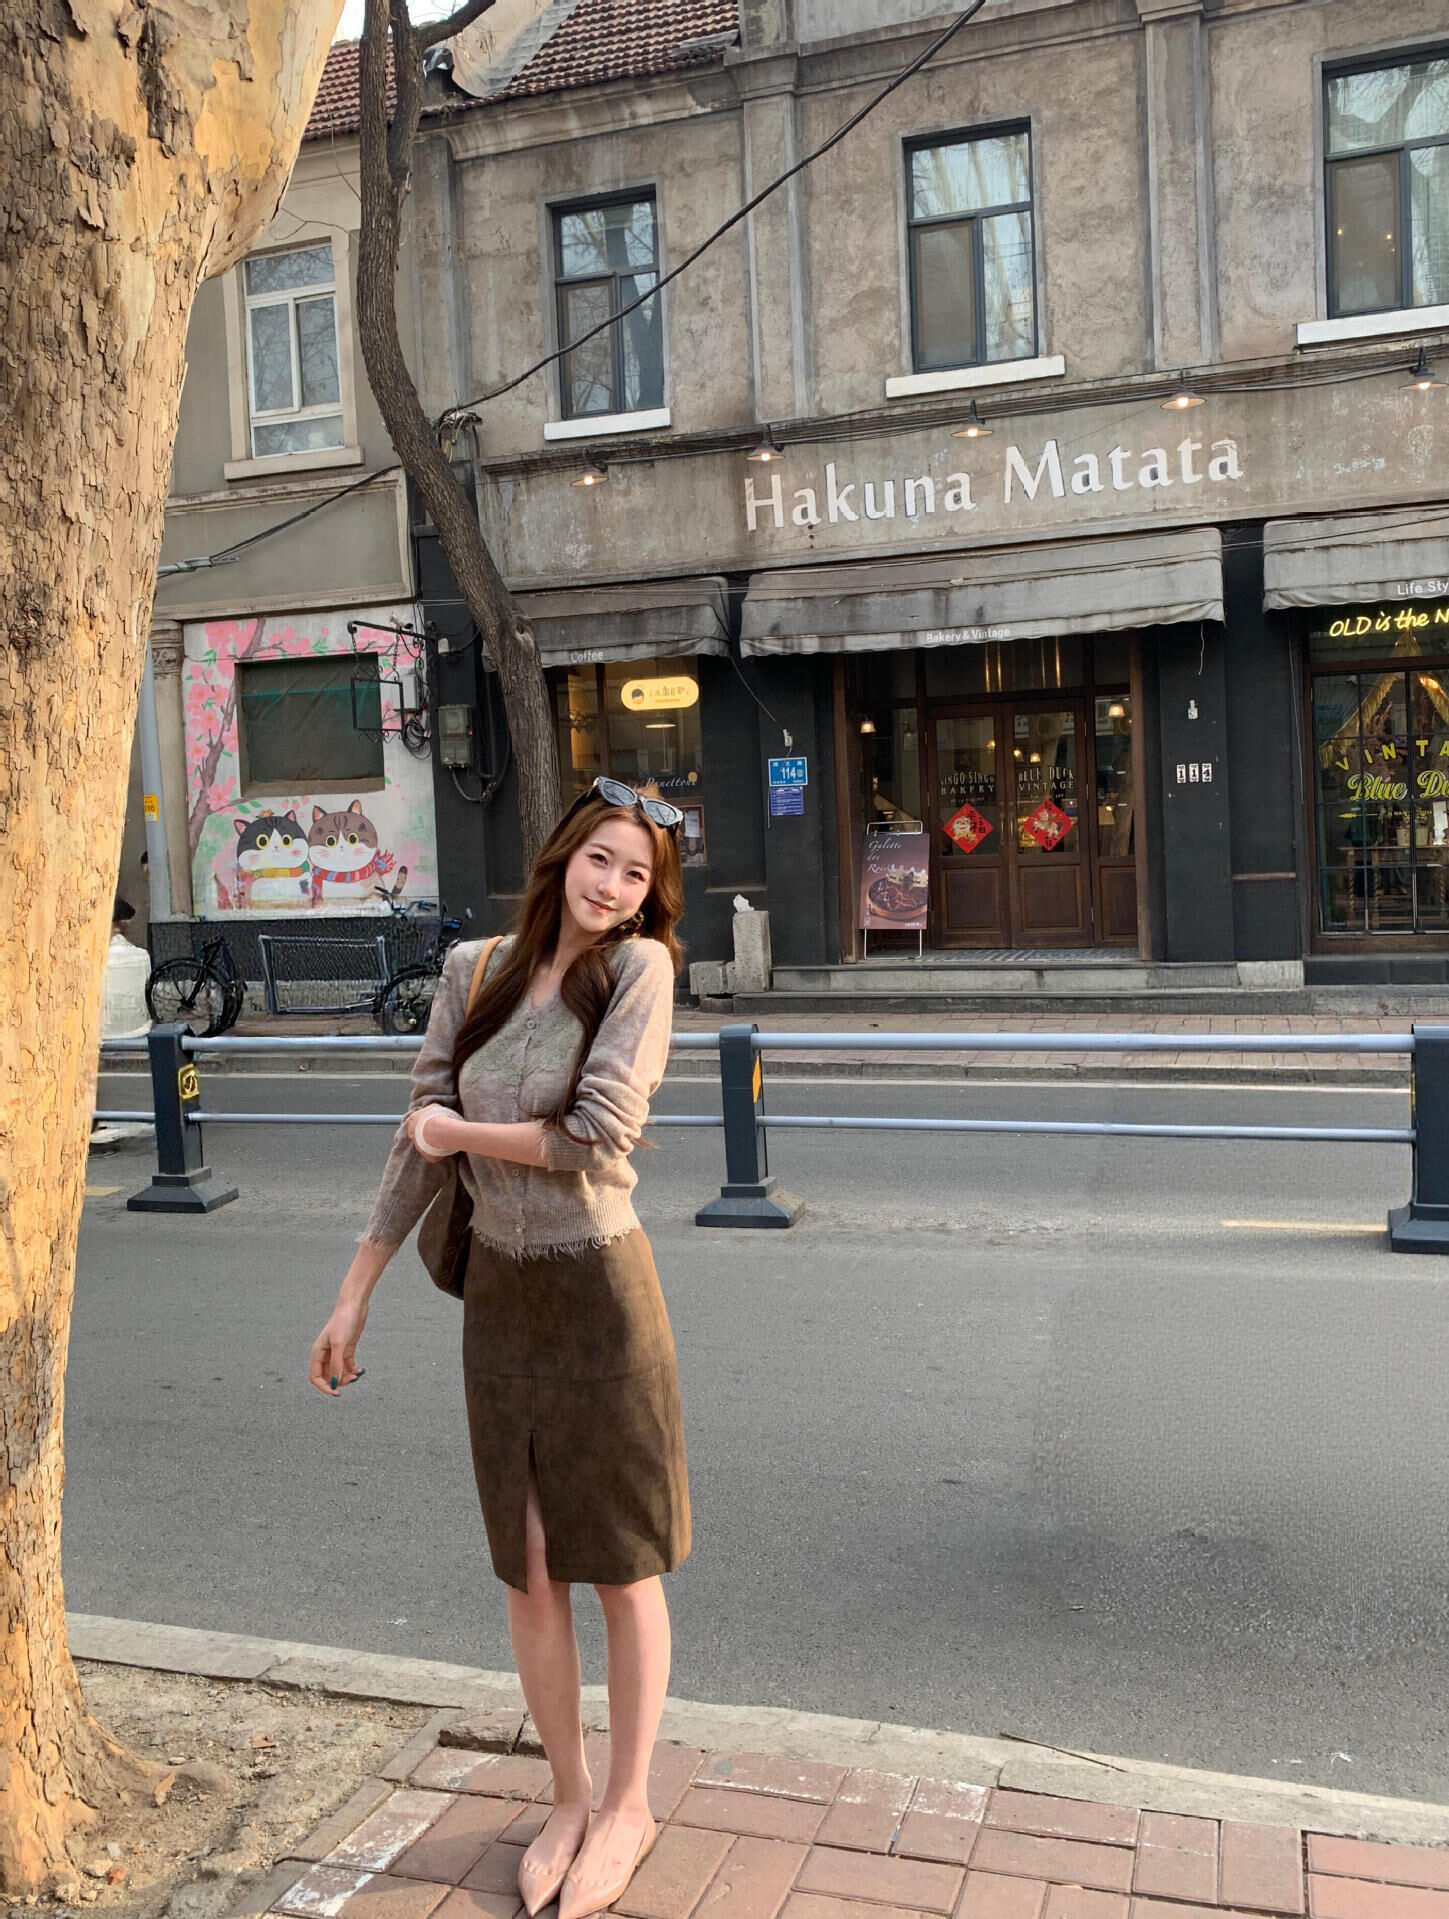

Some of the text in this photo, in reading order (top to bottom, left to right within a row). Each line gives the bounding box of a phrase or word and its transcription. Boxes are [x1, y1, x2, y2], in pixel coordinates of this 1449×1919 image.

[744, 437, 1245, 532] Hakuna Matata
[1397, 582, 1423, 595] Life
[1329, 616, 1371, 637] OLD
[1375, 610, 1391, 631] is
[1394, 608, 1429, 629] the
[926, 628, 1010, 643] Bakery & Vintage
[571, 650, 604, 663] Coffee
[781, 766, 796, 779] 114
[1018, 780, 1074, 791] VINTAGE
[1347, 772, 1408, 801] Blue
